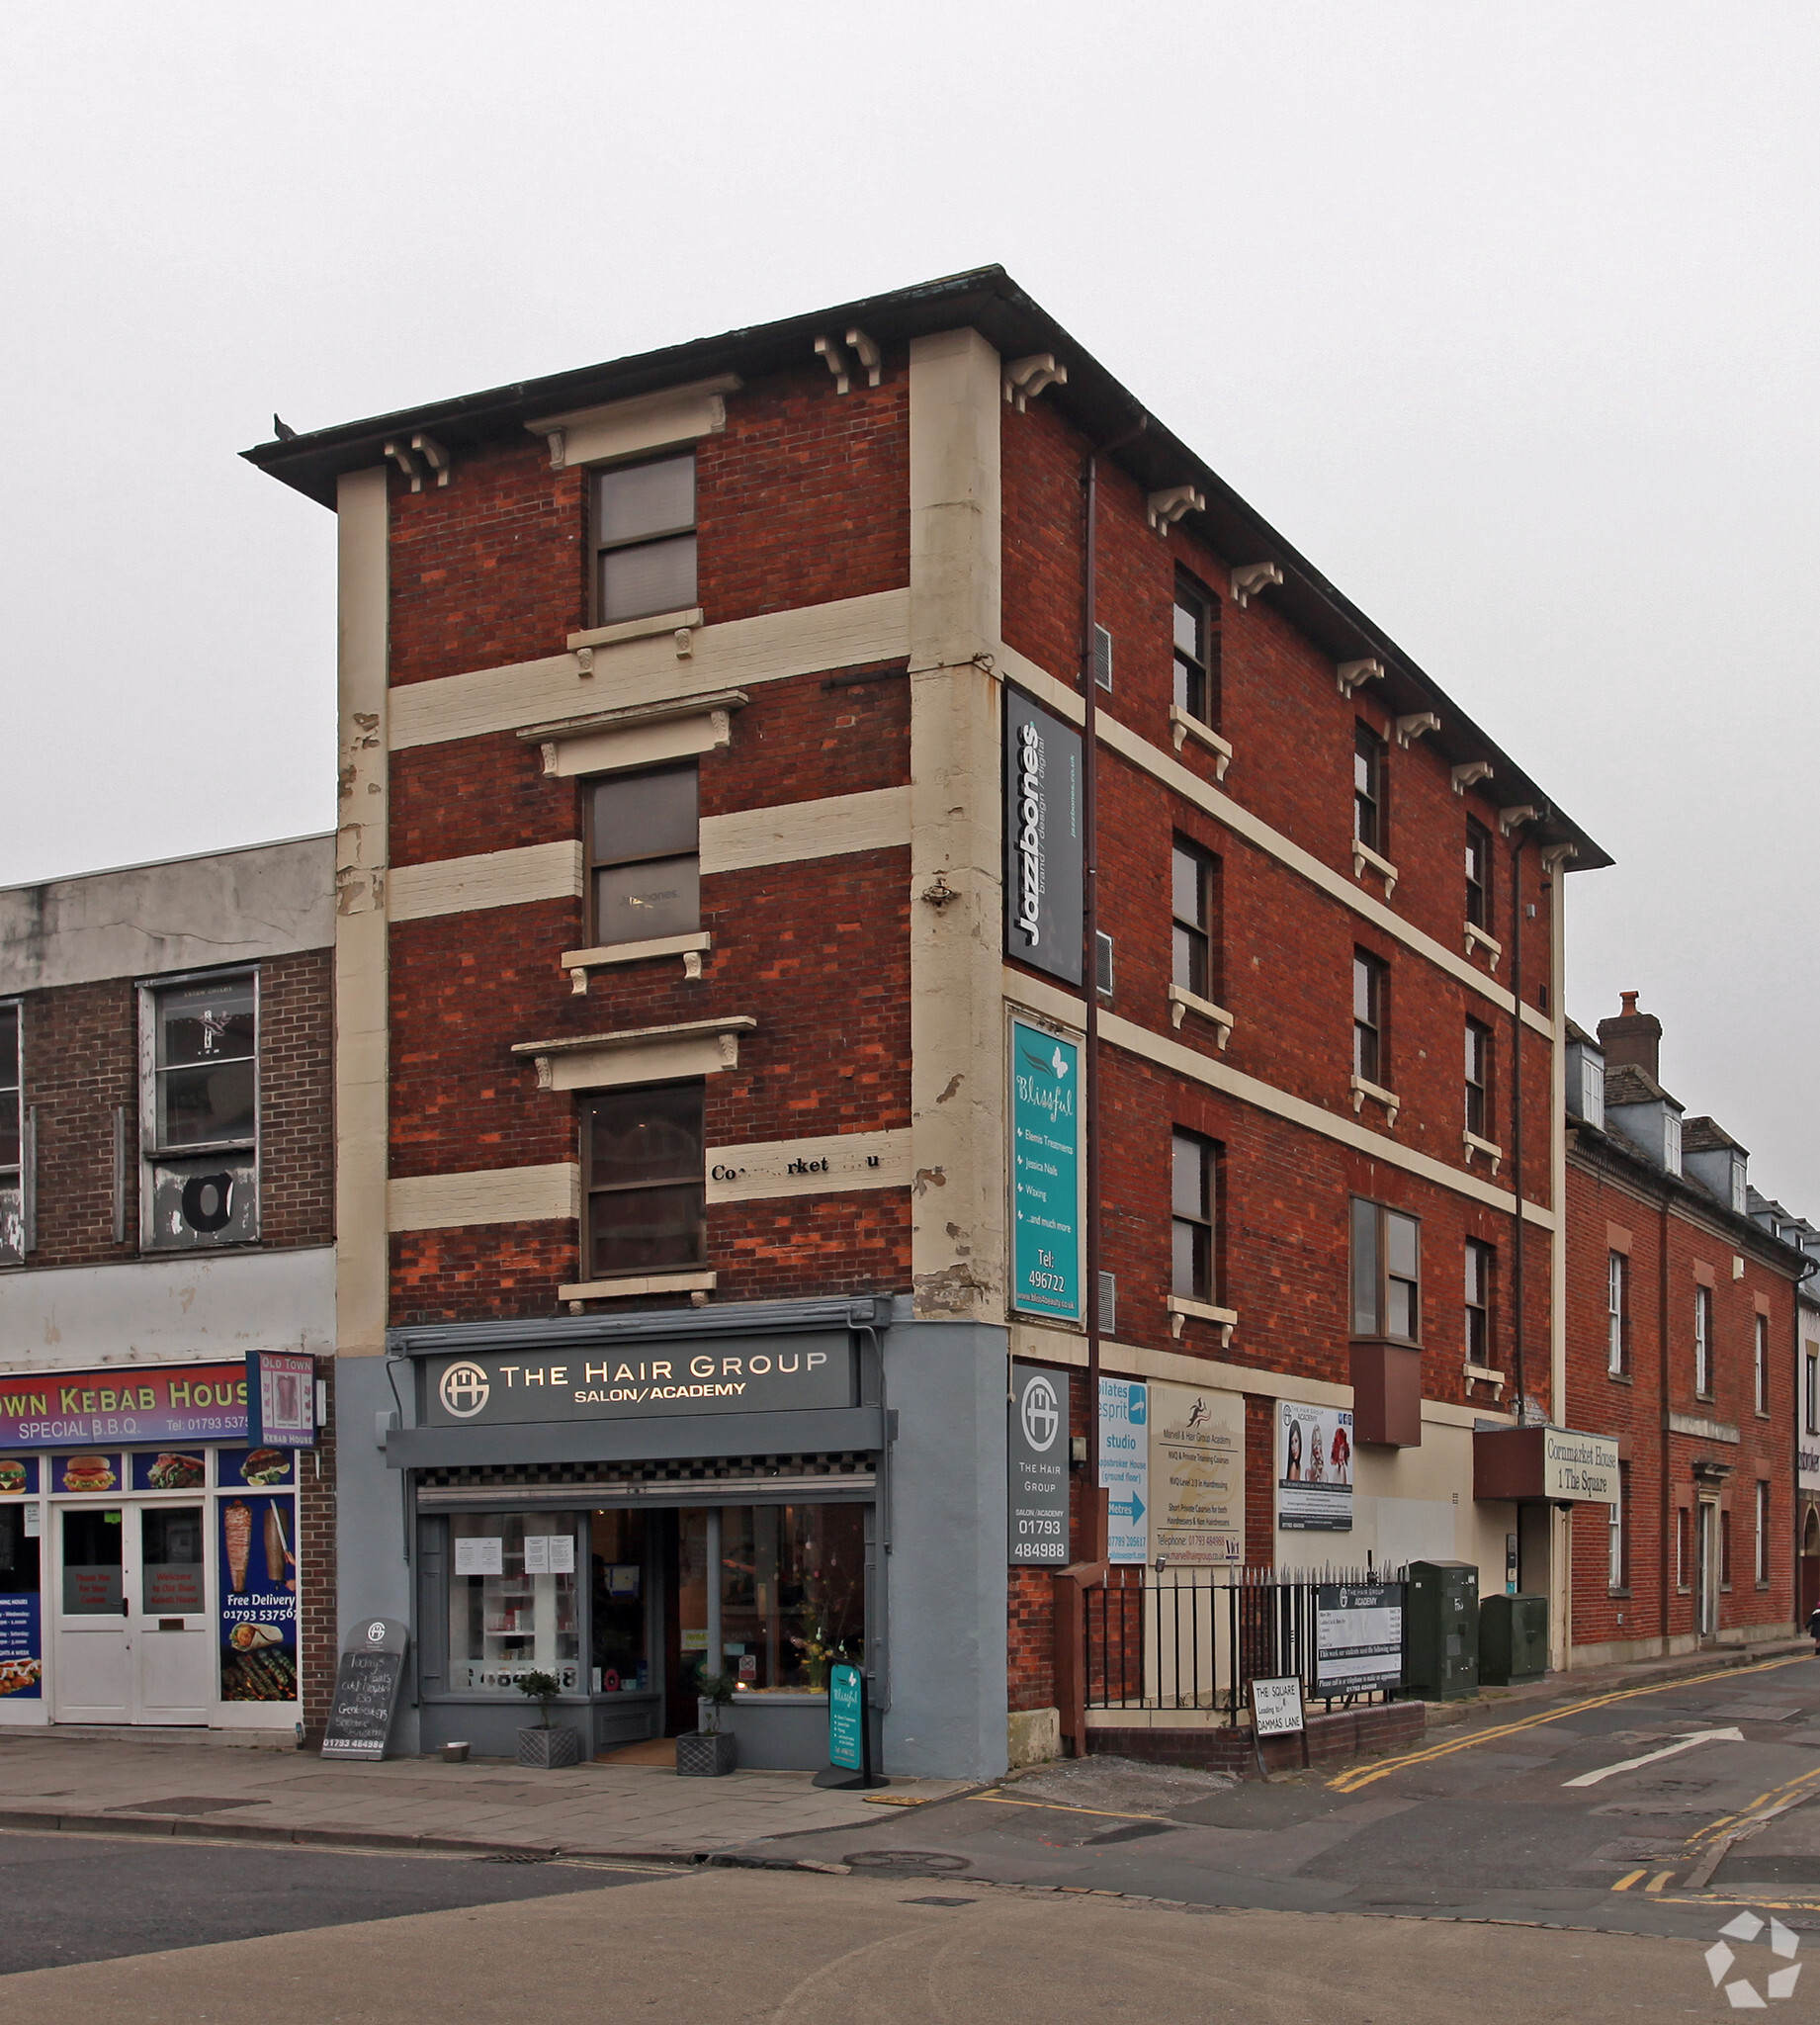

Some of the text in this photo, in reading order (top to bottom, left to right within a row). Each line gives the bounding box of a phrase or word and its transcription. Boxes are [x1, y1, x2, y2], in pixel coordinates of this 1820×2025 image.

[1038, 792, 1047, 840] design
[1038, 853, 1047, 895] brand
[1016, 1075, 1074, 1122] Blissful
[1043, 1132, 1074, 1156] Treatments
[1025, 1156, 1058, 1177] Jessica Nails
[1025, 1184, 1048, 1202] Waxing
[1041, 1215, 1056, 1230] much
[1056, 1221, 1071, 1234] more
[1037, 1248, 1055, 1269] Tel:
[1028, 1270, 1065, 1293] 496722
[262, 1357, 311, 1371] OLD TOWN
[499, 1352, 827, 1387] THE HAIR GROUP
[573, 1382, 746, 1403] SALON/ACADEMY
[60, 1385, 156, 1415] KEBAB
[1297, 1413, 1319, 1422] ACADEMY
[19, 1417, 141, 1440] SPECIAL B.B.Q.
[166, 1419, 185, 1432] Tel:
[188, 1418, 221, 1430] 01793
[263, 1432, 313, 1445] KEBAB HOUSE
[1106, 1435, 1136, 1450] studio
[1180, 1430, 1185, 1441] &
[1185, 1432, 1196, 1442] Hair
[1196, 1433, 1211, 1445] Group
[1211, 1434, 1232, 1447] Academy
[1182, 1452, 1197, 1462] Private
[1197, 1453, 1214, 1464] Training
[1213, 1454, 1230, 1465] Courses
[1547, 1438, 1616, 1468] Cornmarket House
[1019, 1461, 1061, 1475] THE HAIR
[1130, 1459, 1147, 1470] House
[1101, 1470, 1141, 1485] (ground floor)
[1179, 1477, 1191, 1487] Level
[1203, 1479, 1228, 1491] Hairdressing
[1558, 1468, 1607, 1498] 1 The Square
[1024, 1480, 1056, 1493] GROUP
[1108, 1503, 1133, 1515] Metres
[1169, 1503, 1180, 1512] Short
[1180, 1503, 1195, 1513] Private
[1195, 1504, 1211, 1514] Courses
[1018, 1520, 1061, 1535] 01793
[1167, 1516, 1192, 1526] Hairdressers
[1157, 1534, 1226, 1548] Telephone: 01793 484988
[1014, 1542, 1065, 1558] 484988
[156, 1573, 192, 1582] Welcome
[227, 1594, 296, 1608] Free Delivery
[1353, 1597, 1378, 1606] ACADEMY
[222, 1610, 257, 1622] 01793
[1319, 1679, 1332, 1688] Please
[1257, 1684, 1296, 1698] THE SQUARE
[1257, 1706, 1275, 1715] Leading
[1257, 1716, 1301, 1731] DAMMAS LANE
[322, 1738, 350, 1748] 01793
